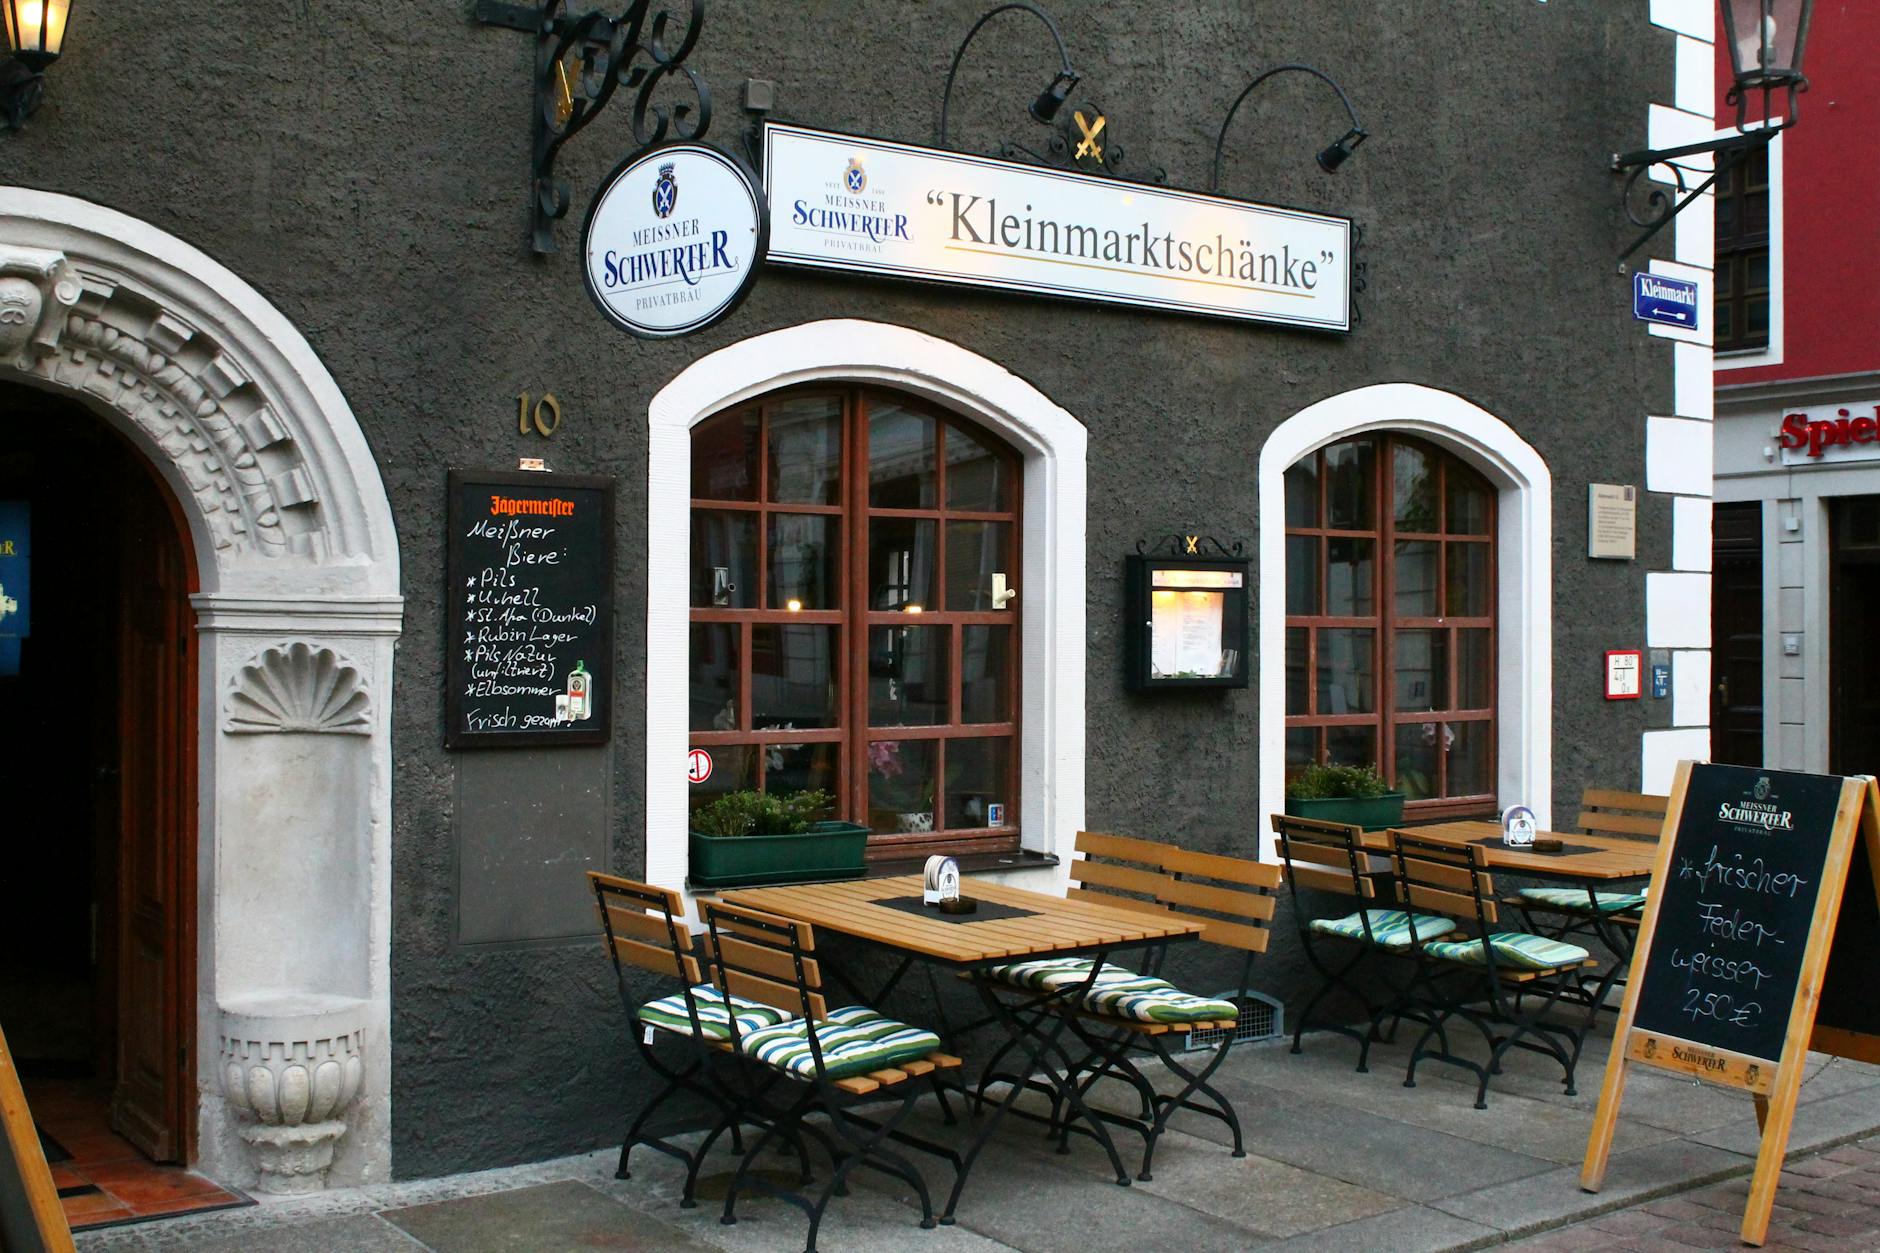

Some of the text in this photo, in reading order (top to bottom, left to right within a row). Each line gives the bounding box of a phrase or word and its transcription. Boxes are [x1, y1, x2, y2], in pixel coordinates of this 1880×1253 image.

[825, 194, 886, 214] MEISSNER
[632, 218, 700, 248] MEISSNER
[793, 199, 911, 244] SCHWERTER
[604, 230, 739, 288] SCHWERTER
[636, 287, 702, 311] PRIVATBRÄU
[1641, 277, 1696, 306] Kleinmarkt
[517, 391, 561, 438] 10
[467, 519, 556, 549] Meißner
[531, 605, 597, 626] (Dunkel)
[478, 625, 579, 649] Rubin Lager
[502, 644, 557, 663] Natur
[475, 679, 562, 698] Elbsommer
[467, 706, 517, 731] Frisch
[1718, 802, 1792, 831] SCHWERTER
[1740, 800, 1778, 813] MEISSNER
[1695, 845, 1809, 898] frischer
[1671, 1046, 1728, 1073] SCHWERTER
